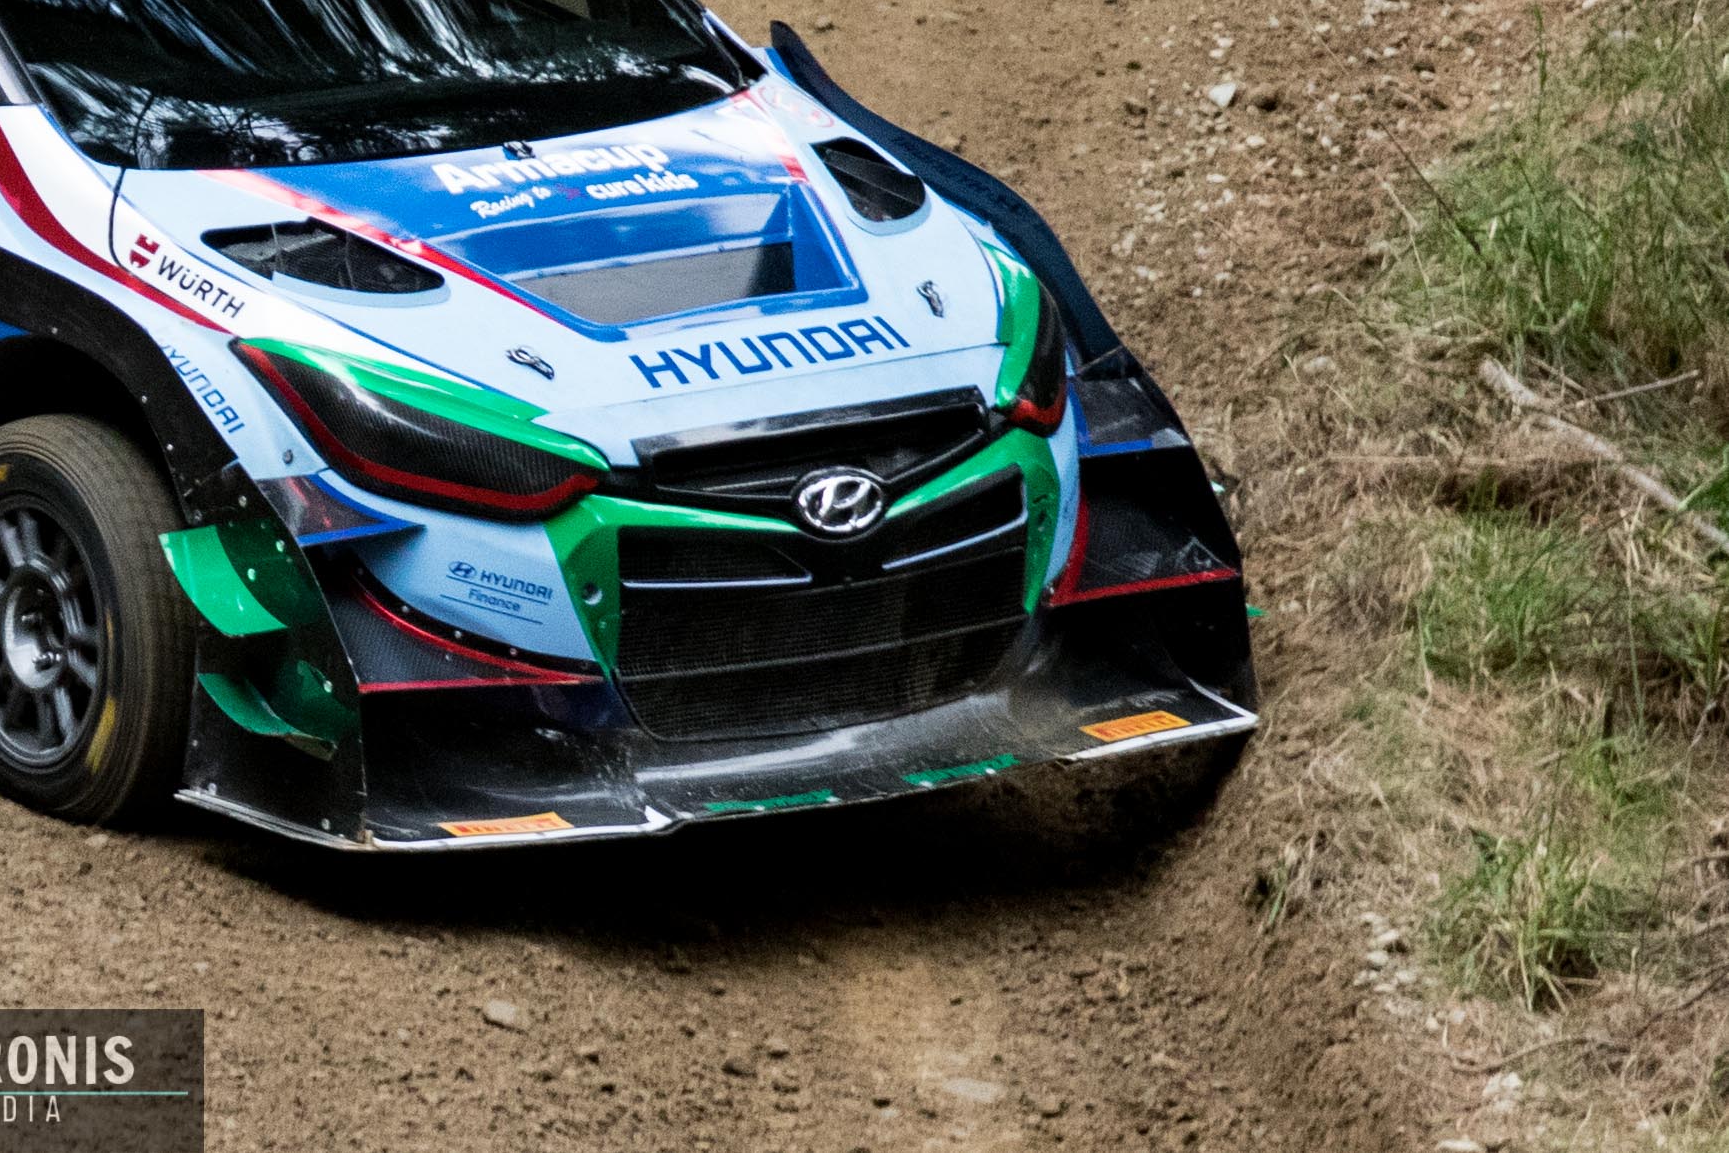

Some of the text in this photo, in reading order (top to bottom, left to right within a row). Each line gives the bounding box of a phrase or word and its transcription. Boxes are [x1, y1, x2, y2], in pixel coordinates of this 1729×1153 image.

[432, 143, 669, 195] Armacup
[470, 169, 699, 220] Racing to cure kids
[157, 255, 245, 319] WÜRTH
[629, 316, 911, 389] HYUNDAI
[469, 588, 521, 612] Finance
[480, 569, 553, 599] HYUNDAI
